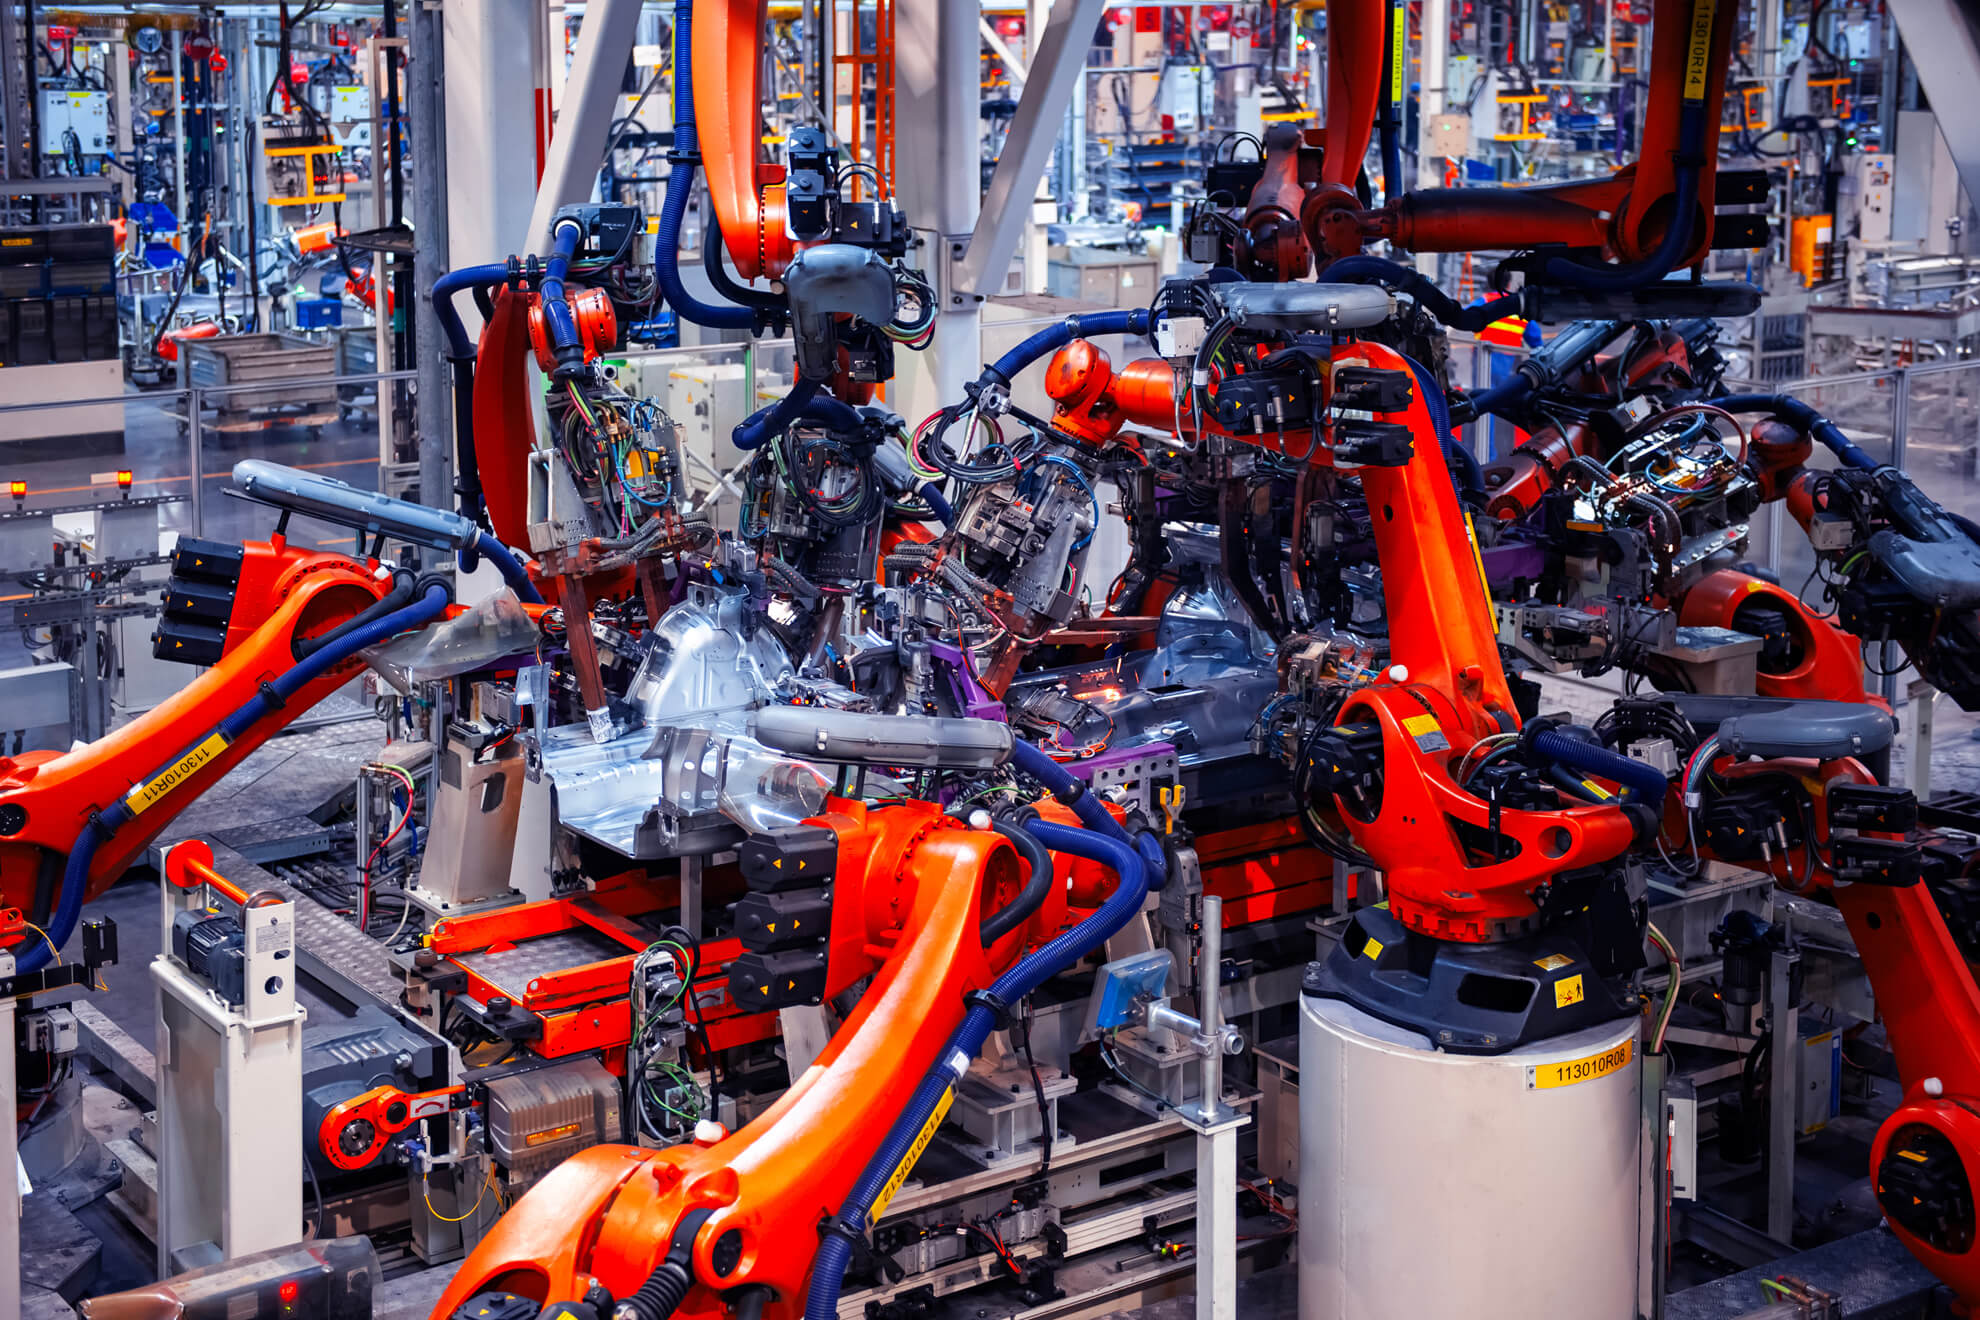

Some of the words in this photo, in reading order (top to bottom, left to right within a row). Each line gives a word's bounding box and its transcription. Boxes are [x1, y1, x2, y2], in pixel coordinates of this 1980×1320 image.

[1690, 6, 1710, 84] 113010R14
[143, 748, 210, 801] 113010R11
[1557, 1048, 1625, 1081] 113010R08
[883, 1112, 941, 1202] 113010R12
